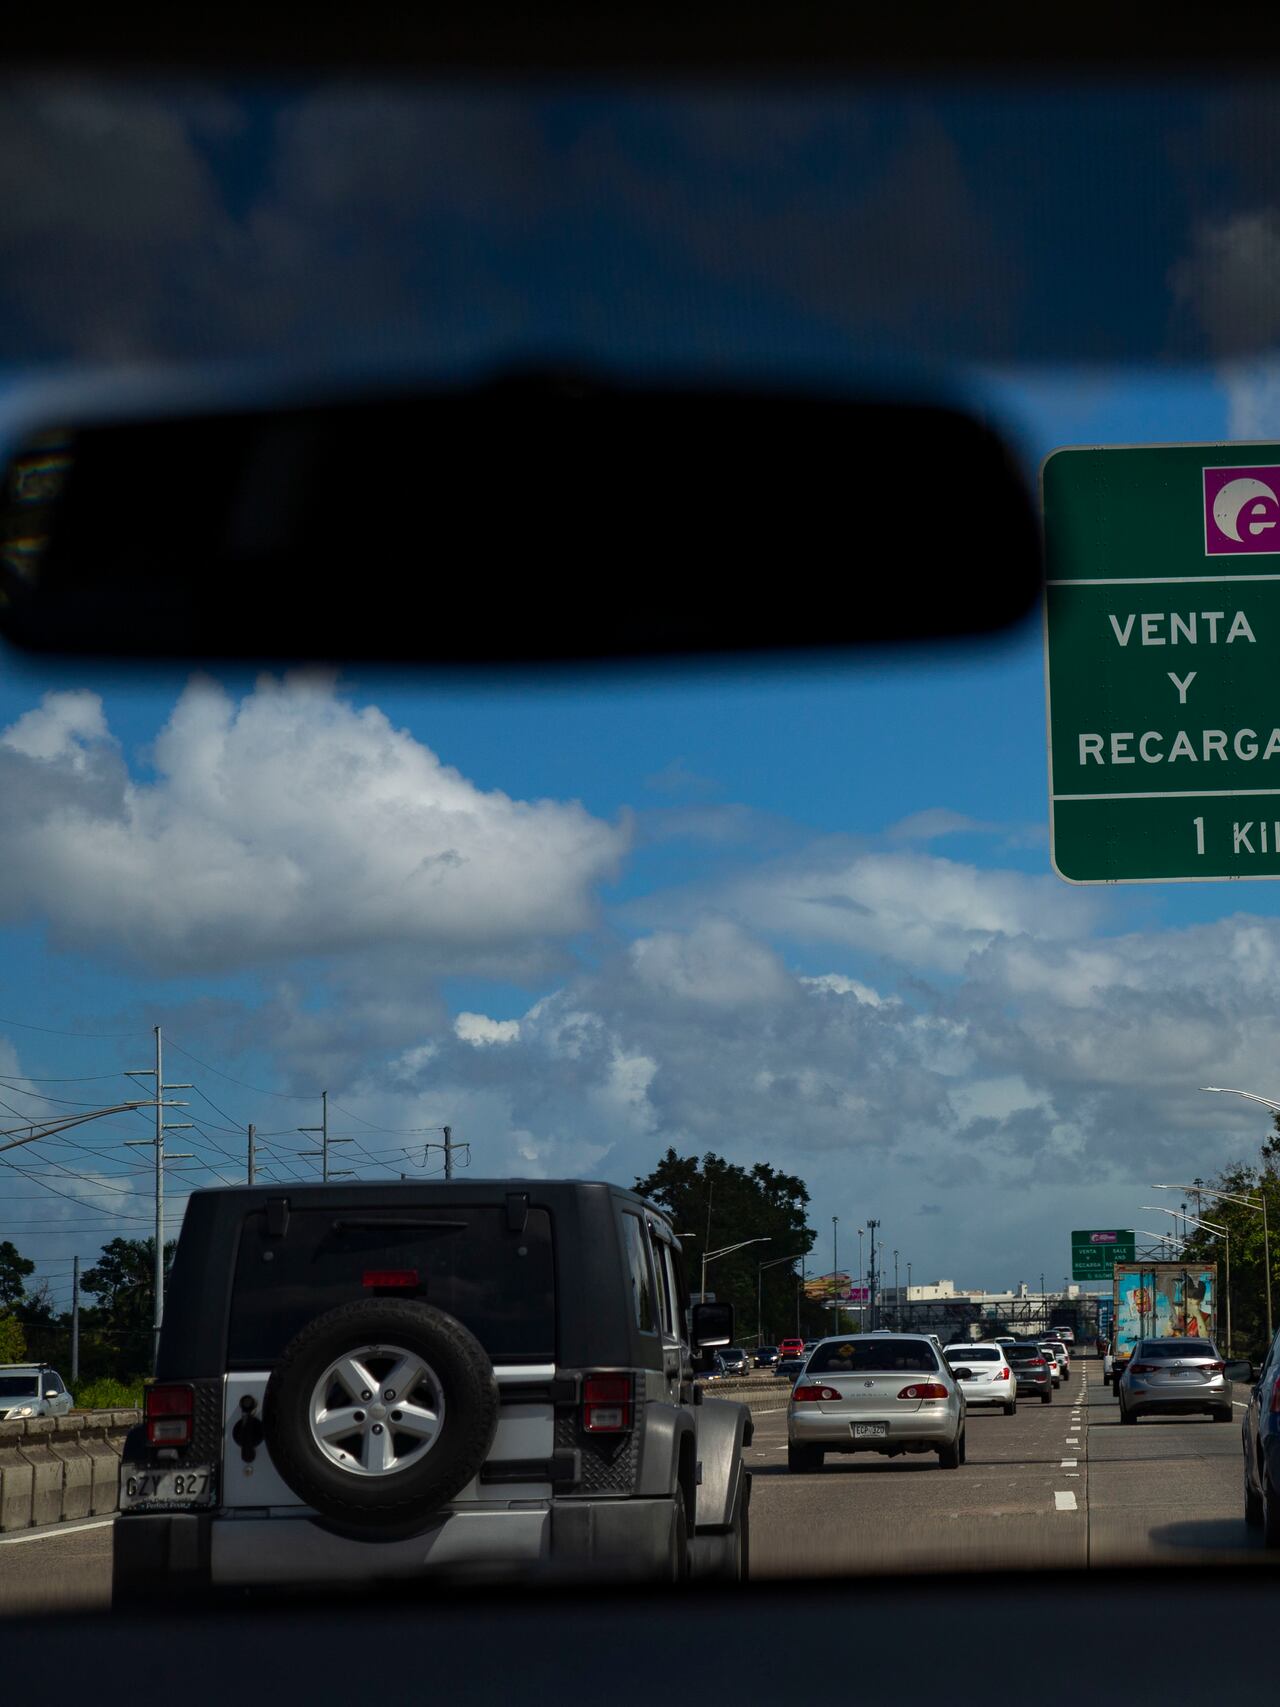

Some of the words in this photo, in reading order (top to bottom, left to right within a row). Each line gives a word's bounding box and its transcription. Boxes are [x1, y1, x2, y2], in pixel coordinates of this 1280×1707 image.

[1109, 611, 1256, 646] VENTA
[1167, 671, 1197, 703] Y
[1193, 817, 1206, 855] 1
[127, 1475, 161, 1496] GZY
[175, 1474, 209, 1495] 827
